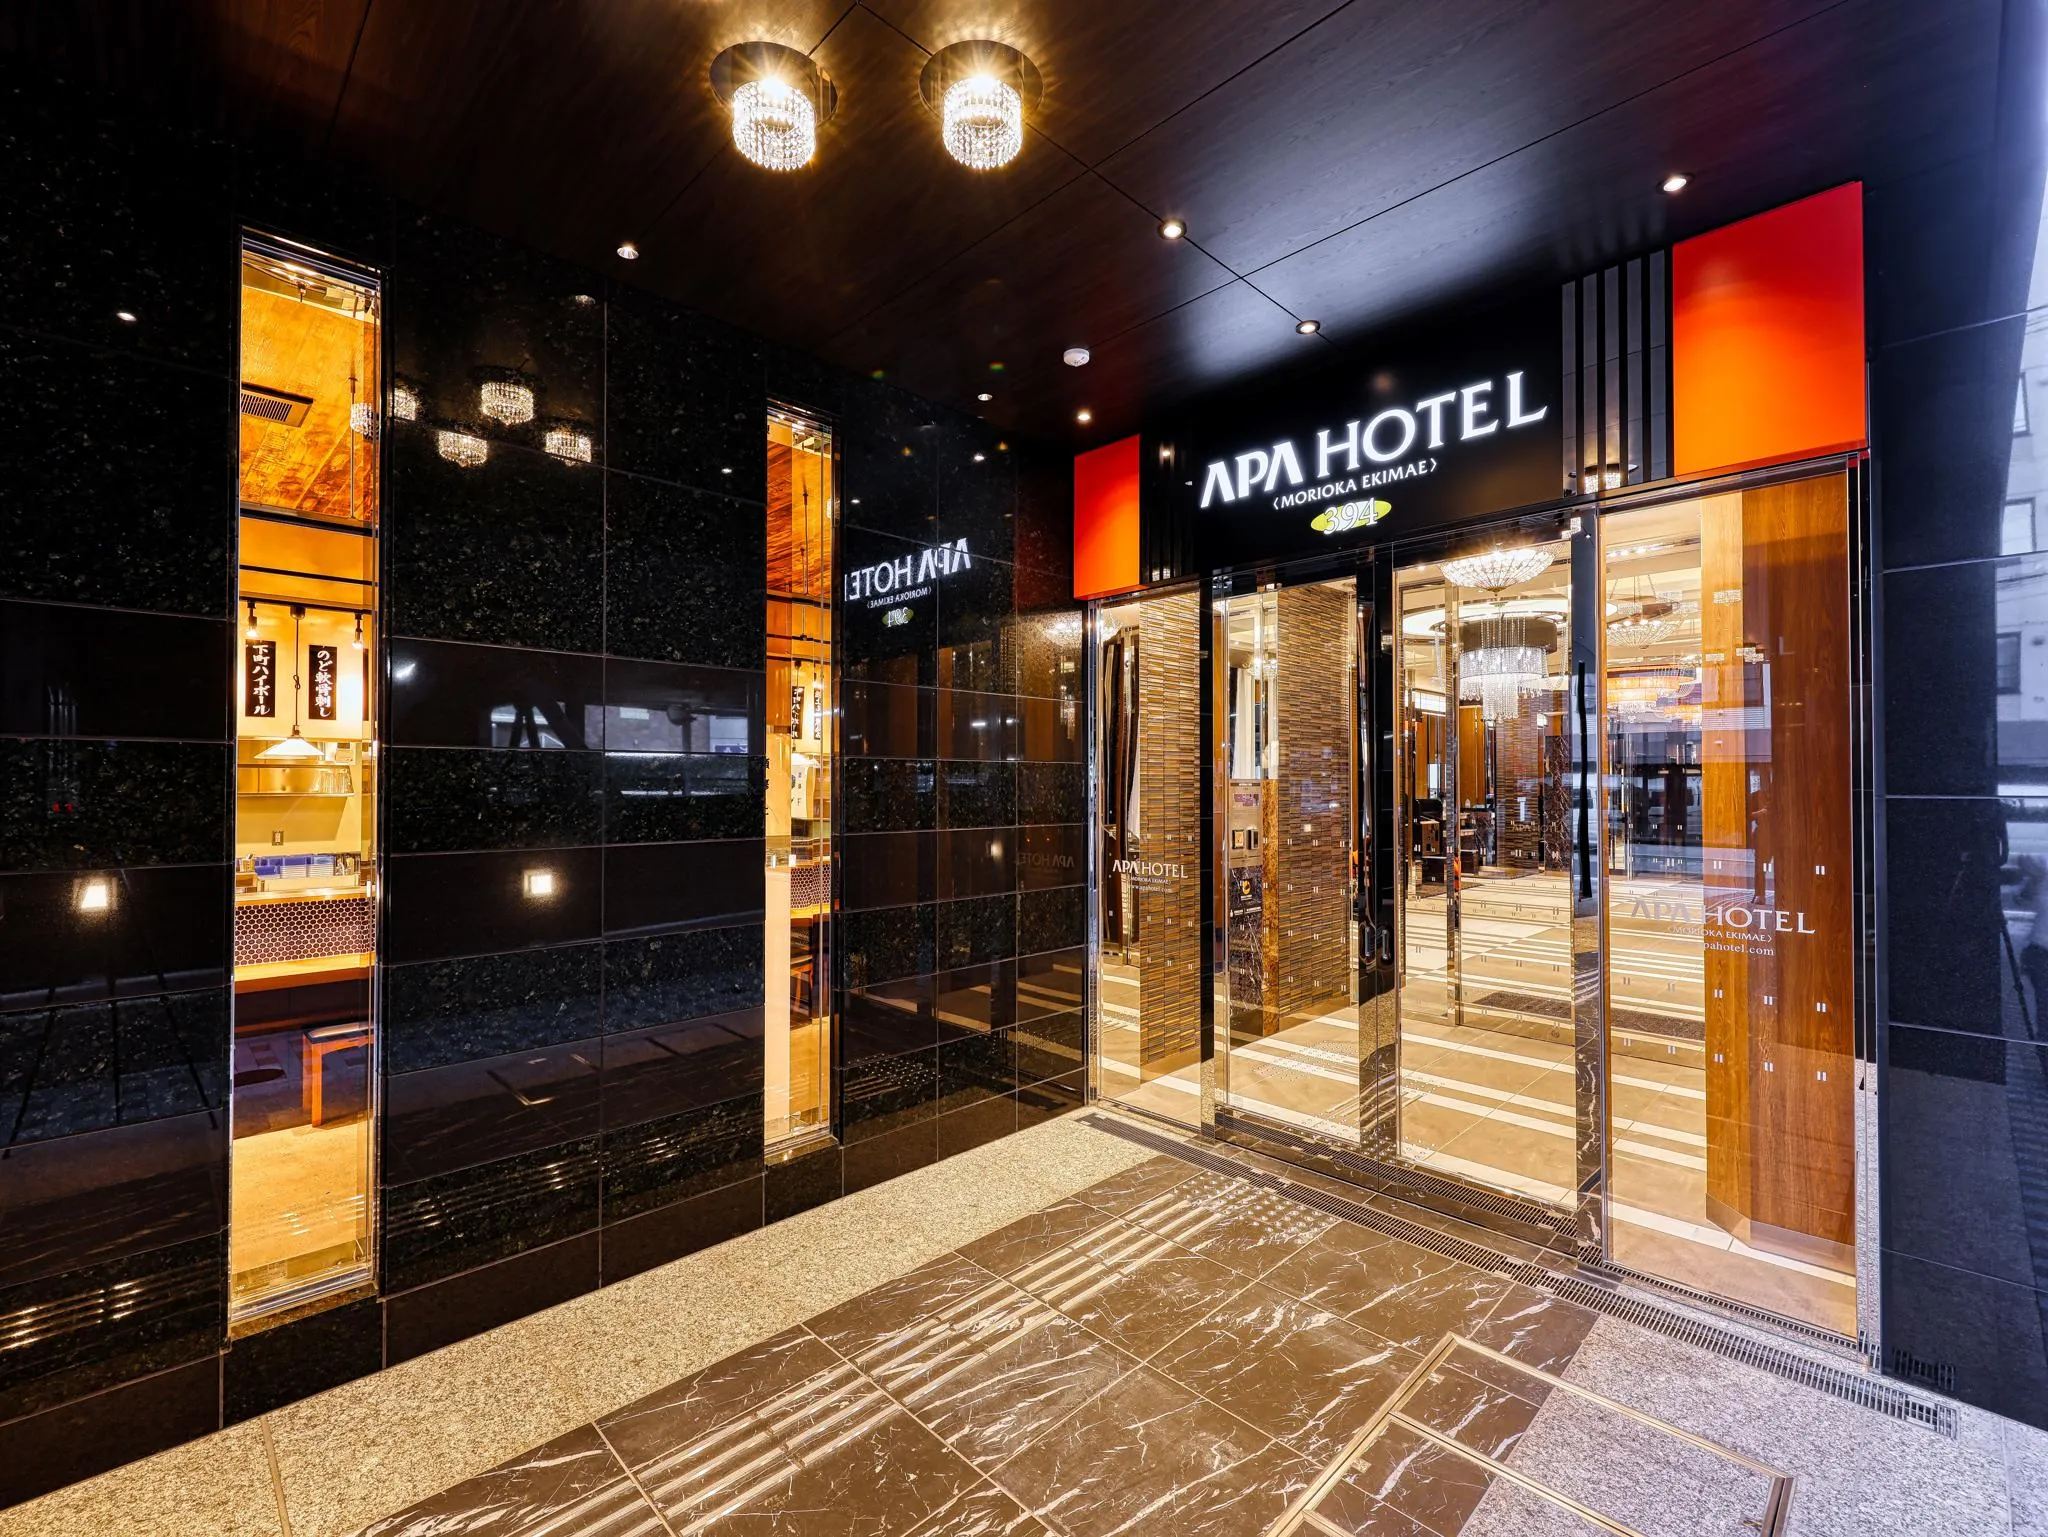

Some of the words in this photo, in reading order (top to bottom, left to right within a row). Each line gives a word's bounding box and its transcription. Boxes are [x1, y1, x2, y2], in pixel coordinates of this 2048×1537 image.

[1200, 441, 1303, 508] APA
[1316, 371, 1548, 479] HOTEL
[1323, 497, 1379, 534] 394
[252, 644, 270, 716] 下町ハイボール
[315, 650, 333, 718] のど軟骨刺し
[1112, 859, 1139, 875] APA
[1141, 861, 1189, 879] HOTEL
[1631, 895, 1693, 923] APA
[1702, 903, 1816, 935] HOTEL
